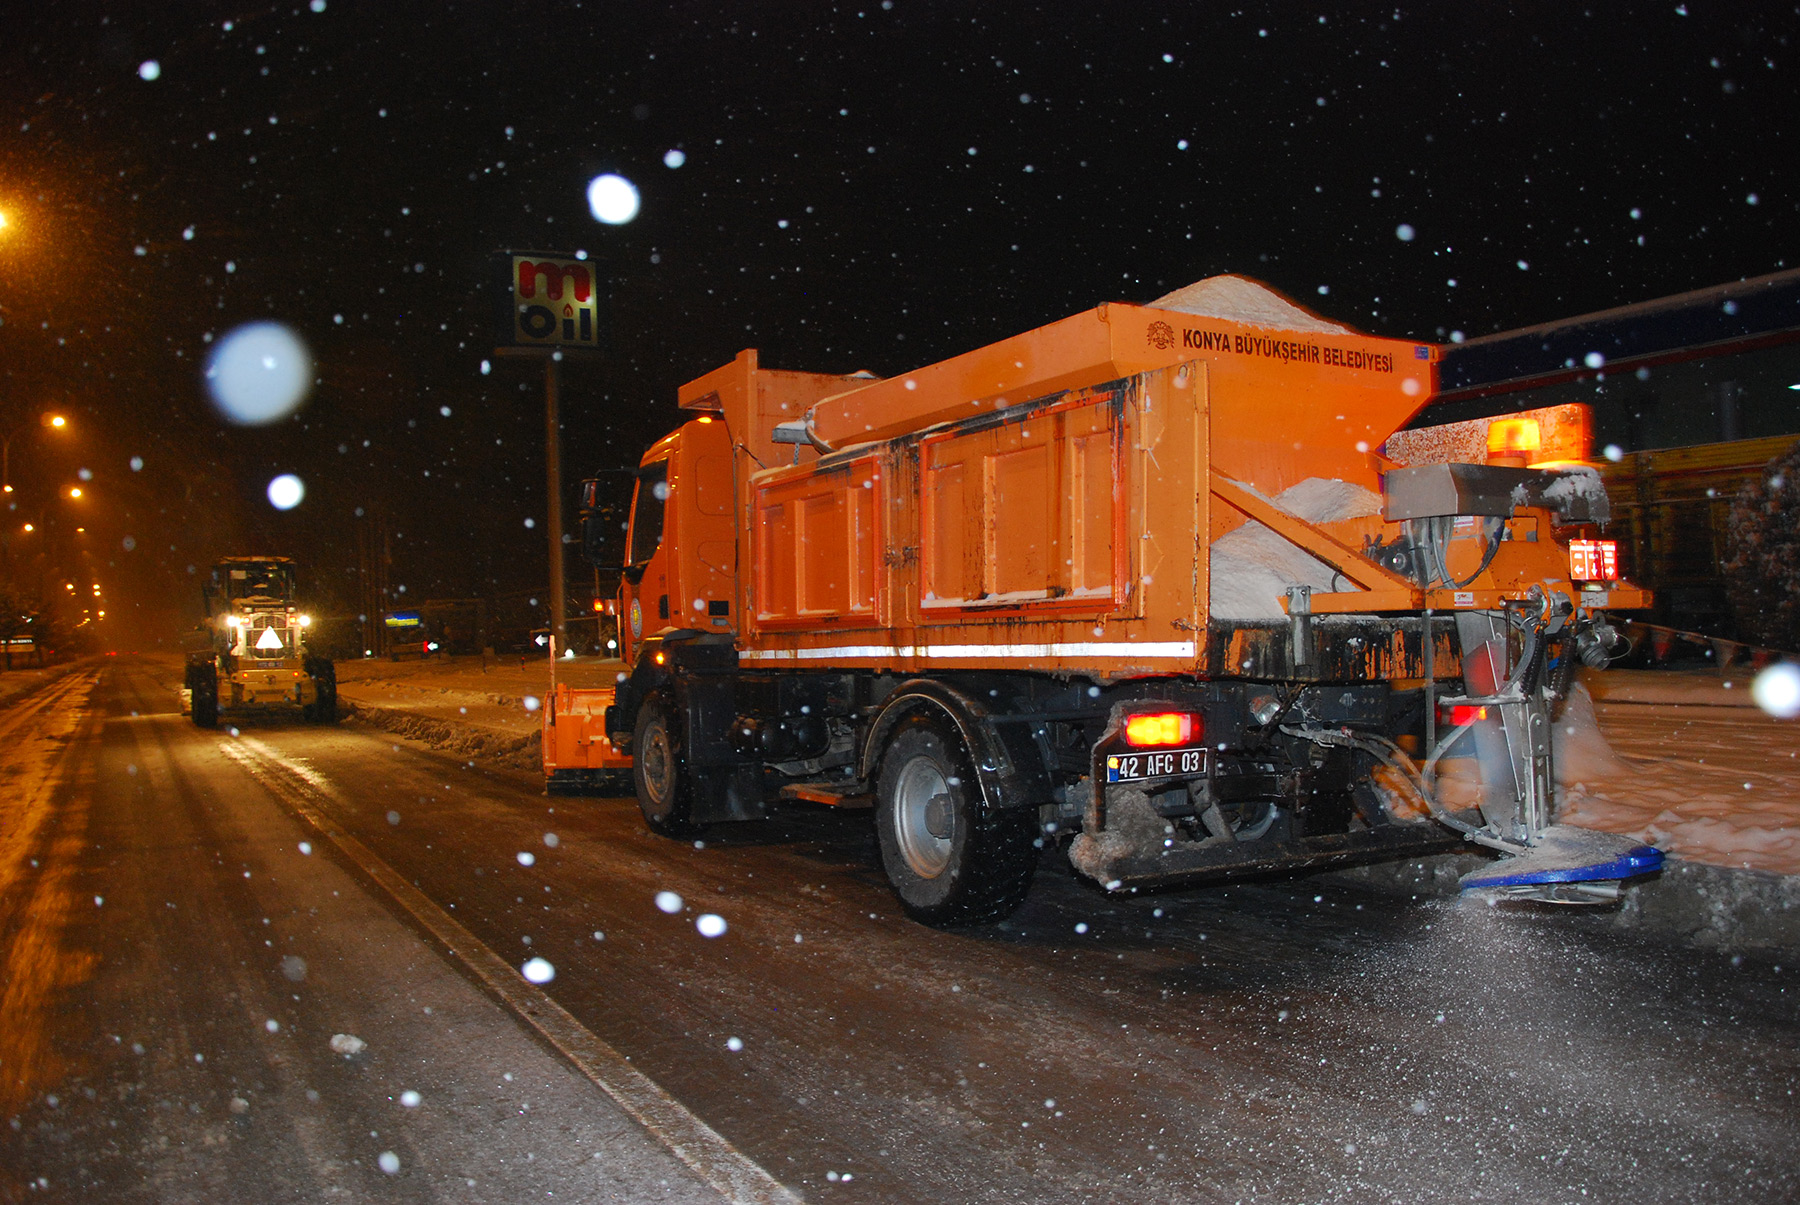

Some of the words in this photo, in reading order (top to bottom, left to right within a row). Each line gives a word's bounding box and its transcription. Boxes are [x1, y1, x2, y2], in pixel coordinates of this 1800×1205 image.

[520, 304, 592, 341] oil
[1182, 328, 1231, 353] KONYA
[1235, 332, 1320, 365] BÜYÜKŞEHİR
[1323, 346, 1393, 373] BELEDİYESİ
[1119, 756, 1139, 778] 42
[1147, 754, 1174, 776] AFC
[1181, 751, 1200, 773] 03
